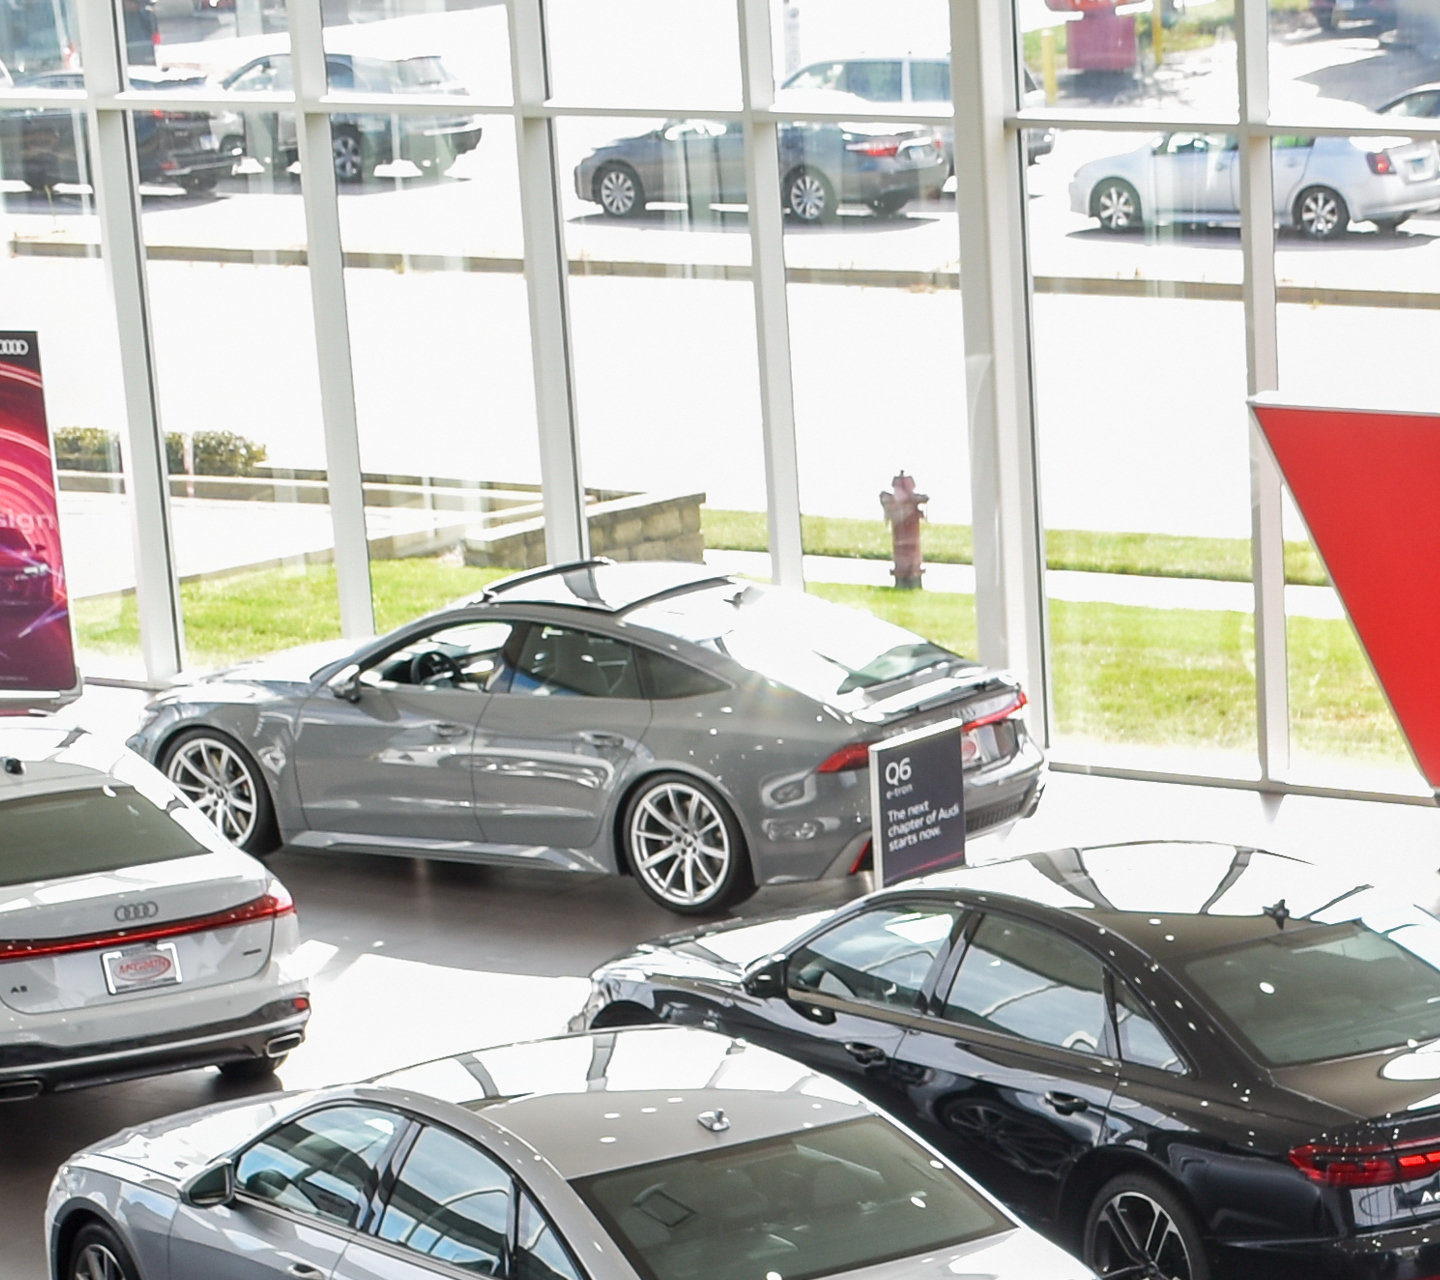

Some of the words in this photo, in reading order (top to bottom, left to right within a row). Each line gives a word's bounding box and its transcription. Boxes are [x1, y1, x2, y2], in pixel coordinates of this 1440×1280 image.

[885, 757, 912, 786] Q6
[886, 783, 913, 800] e-tron
[887, 809, 907, 822] The
[908, 800, 929, 817] next
[888, 817, 924, 838] chapter
[925, 809, 937, 825] of
[938, 802, 959, 820] Audi
[889, 833, 918, 852] starts
